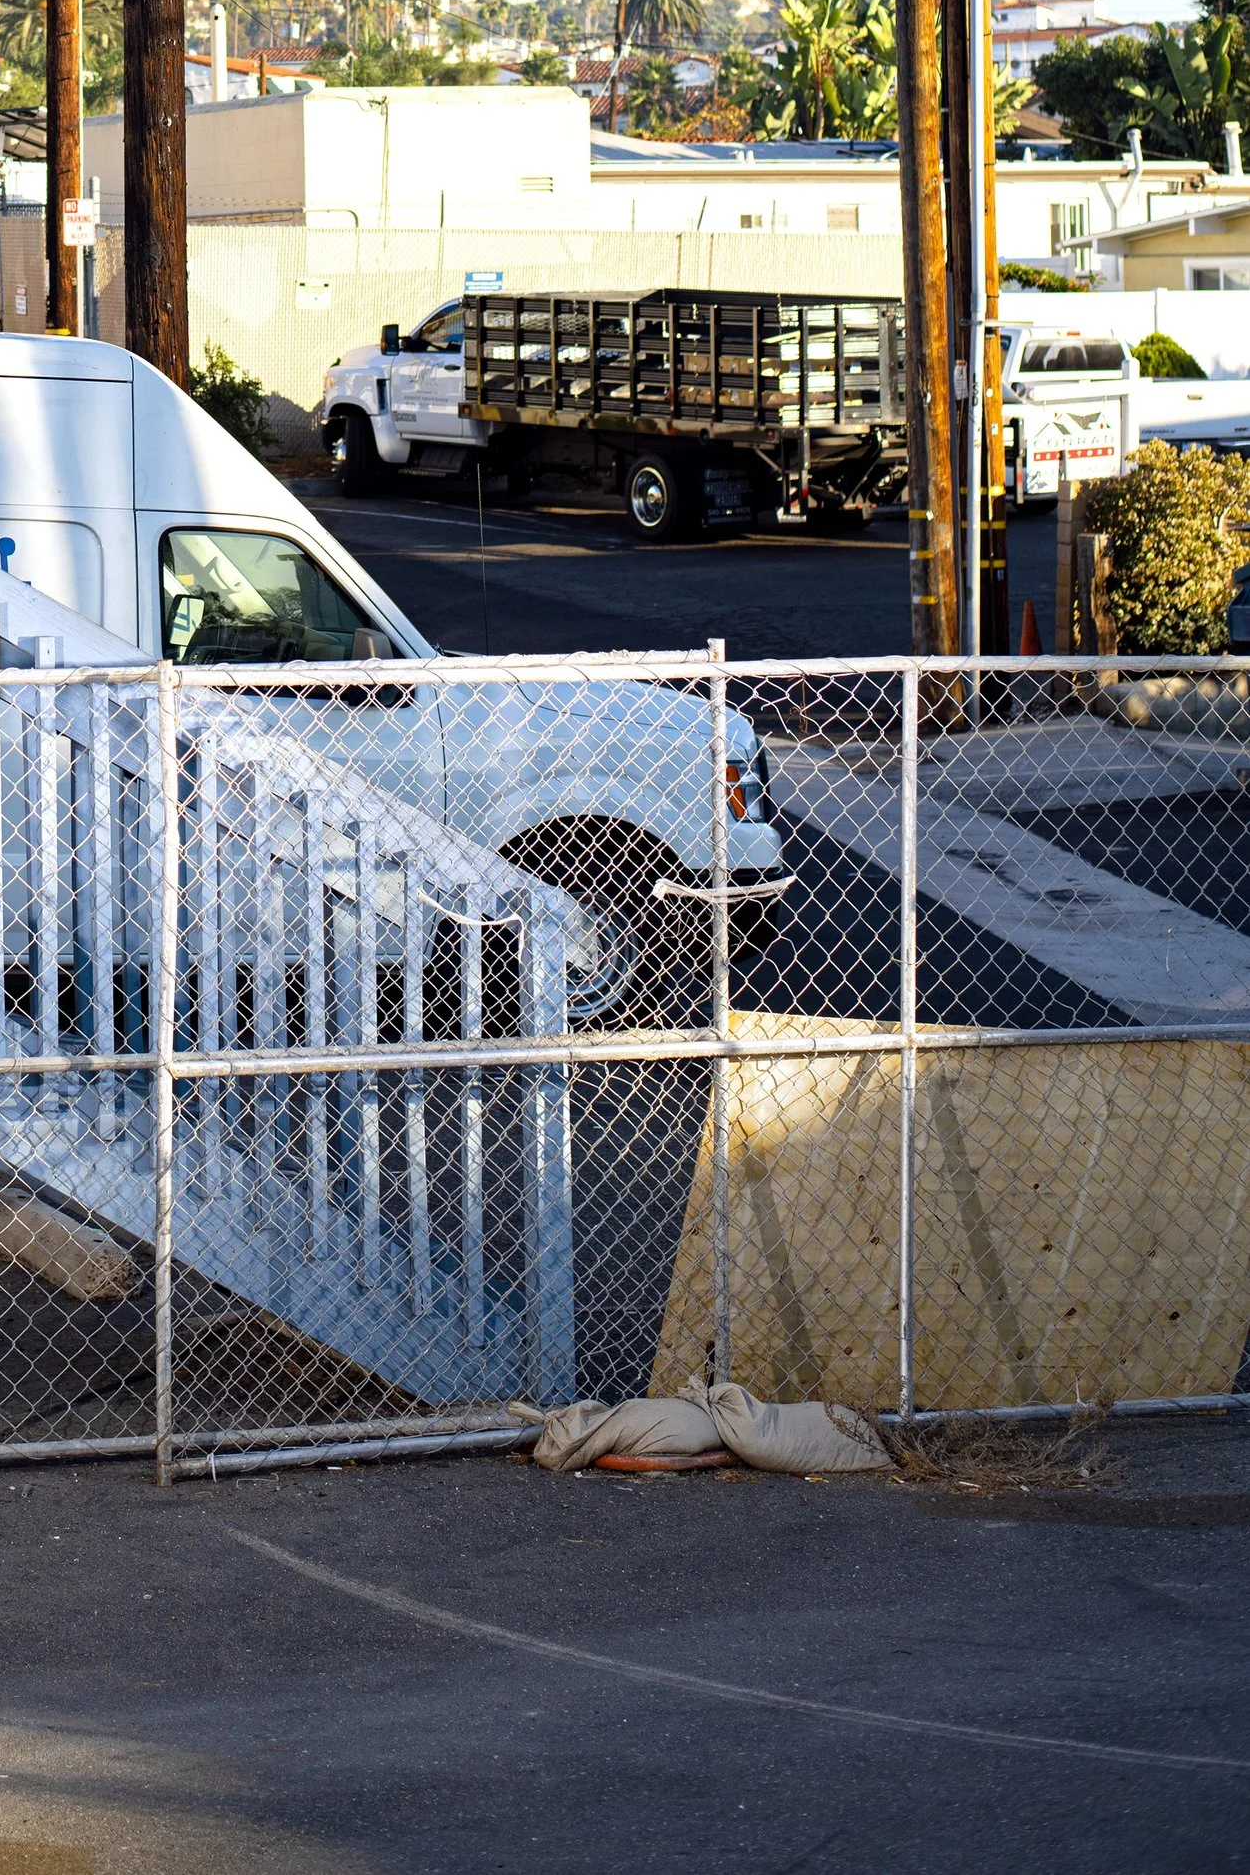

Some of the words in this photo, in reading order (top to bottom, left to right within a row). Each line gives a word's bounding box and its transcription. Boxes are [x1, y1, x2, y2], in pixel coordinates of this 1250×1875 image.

[65, 200, 77, 213] NO
[66, 215, 92, 224] PARKING
[1033, 434, 1114, 449] CONRAD
